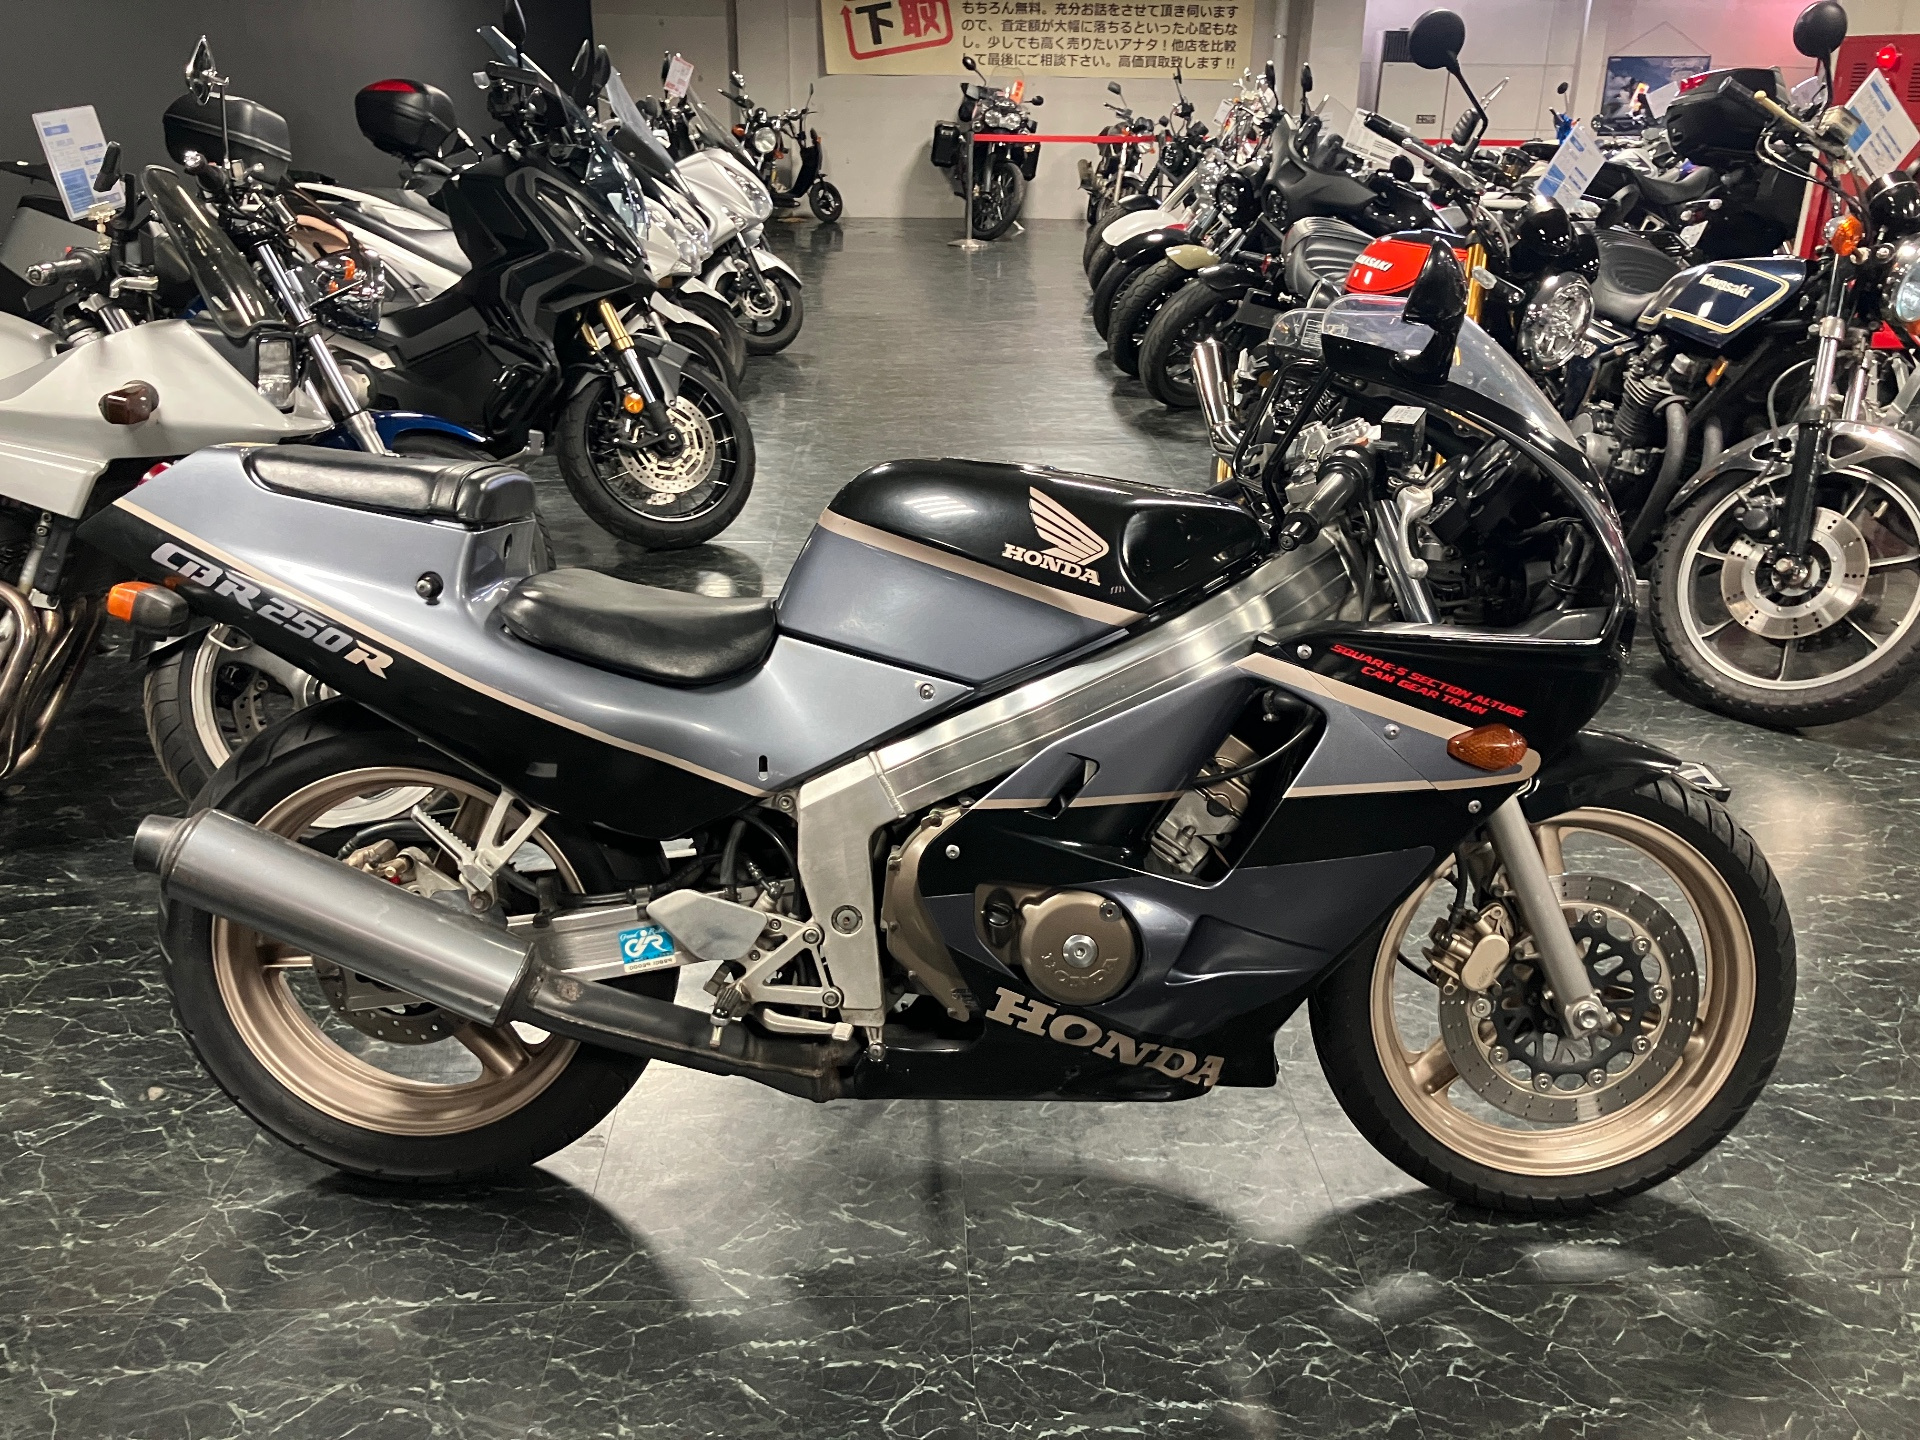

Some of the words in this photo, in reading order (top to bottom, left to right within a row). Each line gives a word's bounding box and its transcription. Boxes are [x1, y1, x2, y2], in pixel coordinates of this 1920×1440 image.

[1698, 273, 1755, 299] Kawasaki
[1001, 543, 1101, 587] HONDA
[1360, 666, 1396, 683] CAM
[1396, 679, 1440, 699] GEAR
[1442, 694, 1488, 715] TRAIN
[1407, 672, 1473, 699] SECTION
[985, 986, 1225, 1087] HONDA
